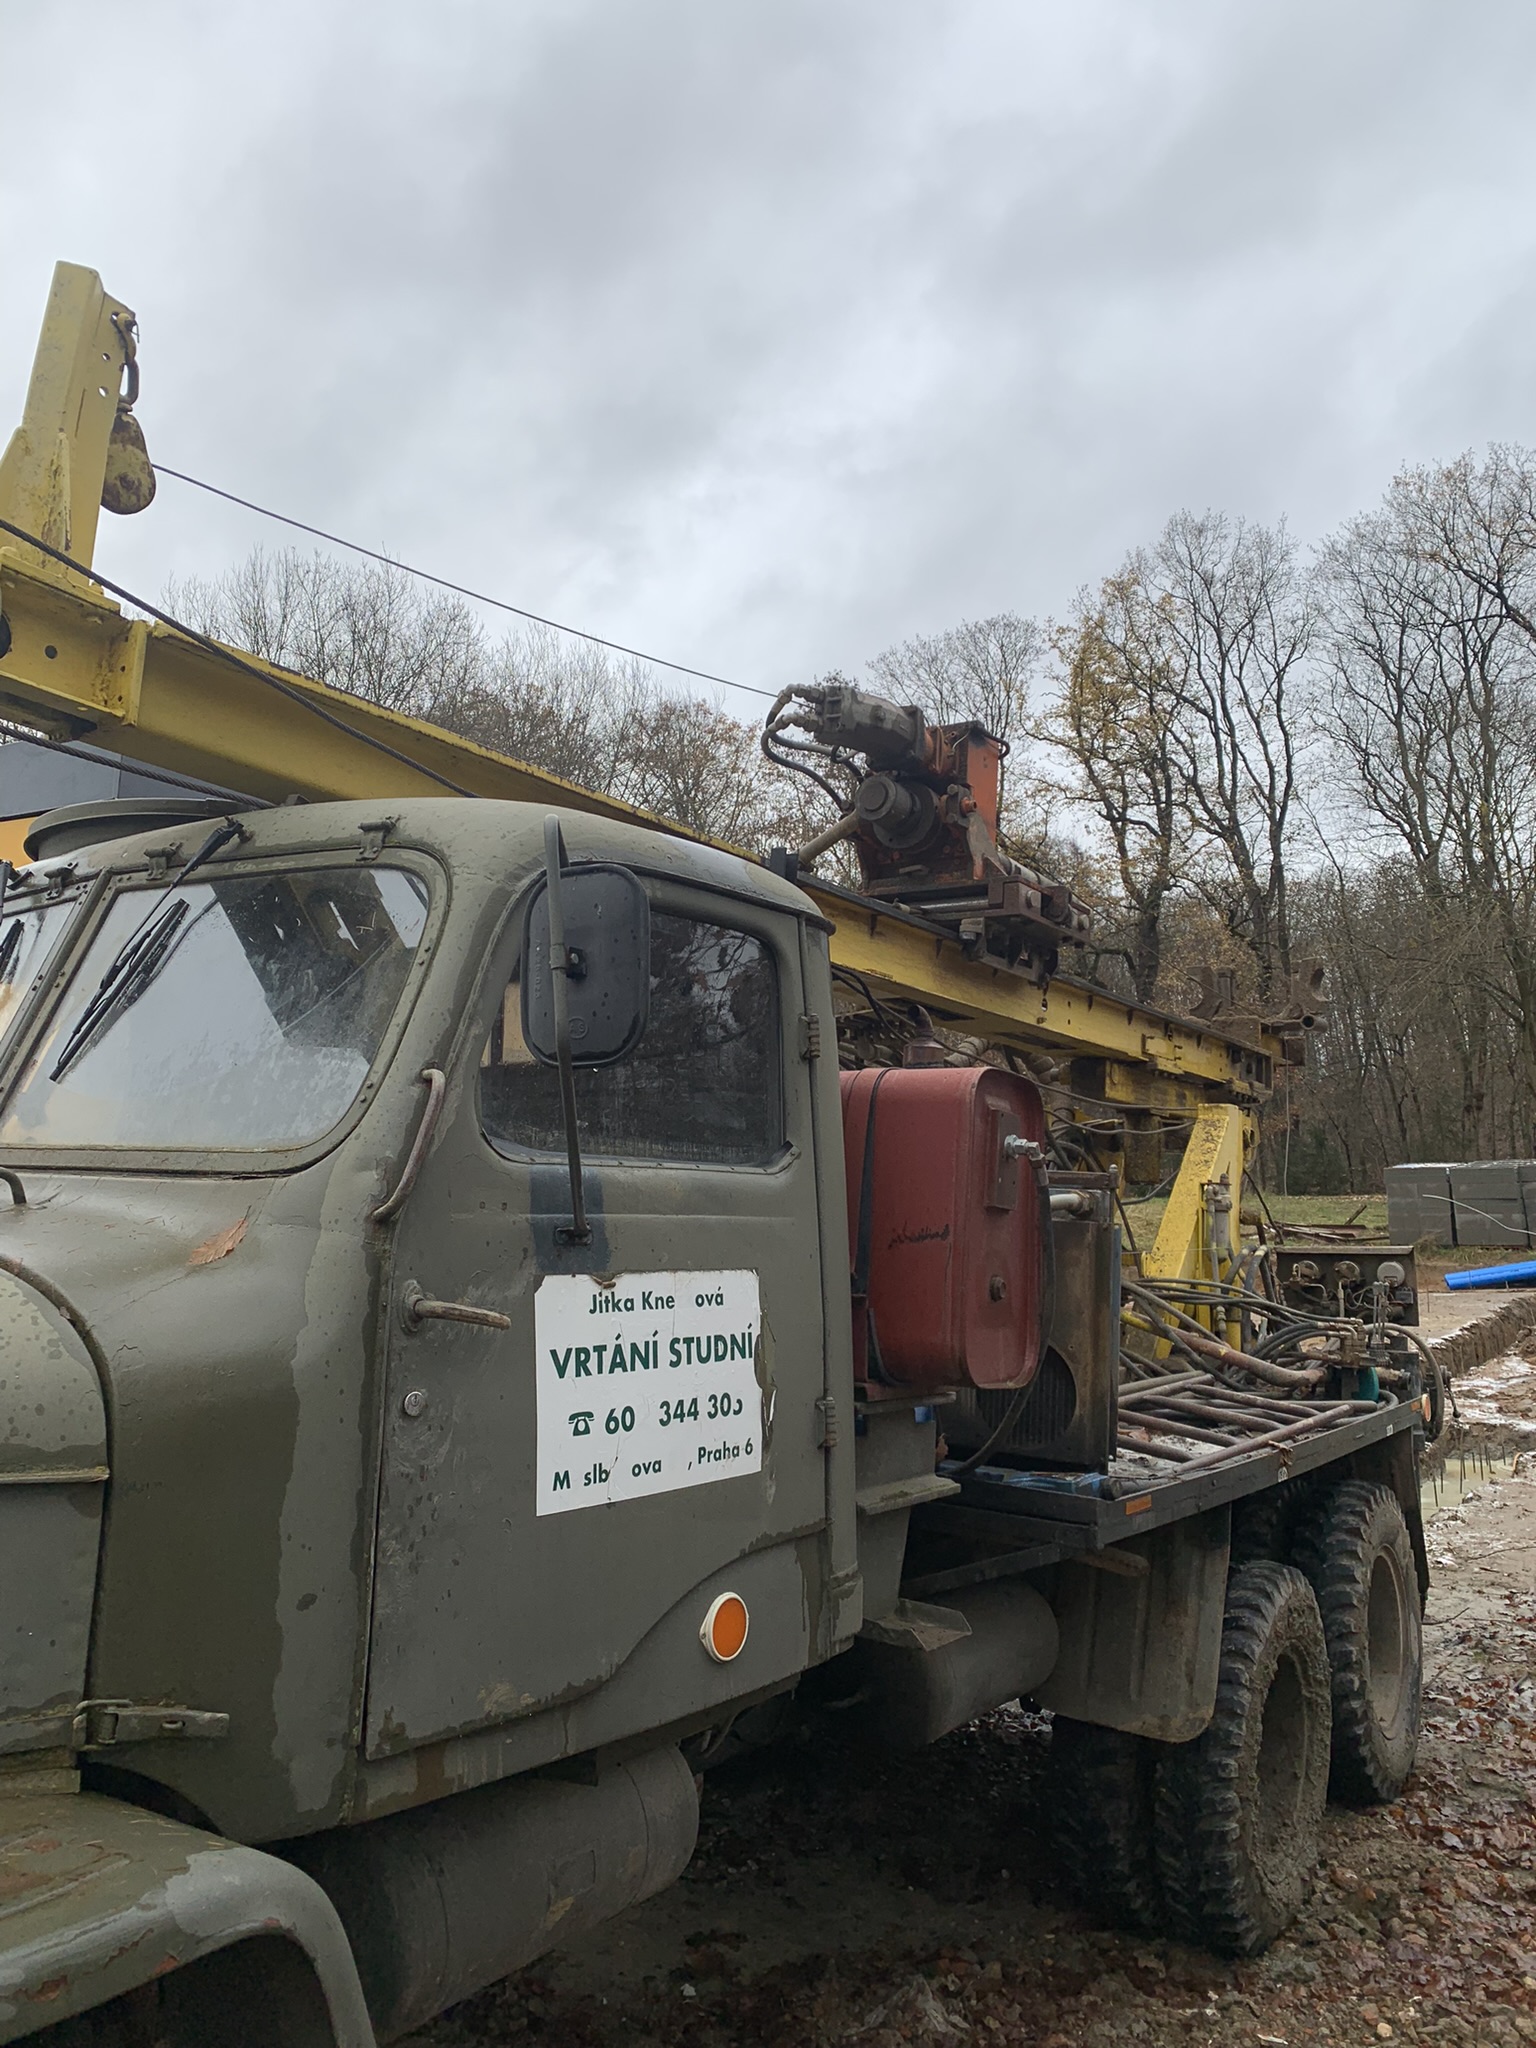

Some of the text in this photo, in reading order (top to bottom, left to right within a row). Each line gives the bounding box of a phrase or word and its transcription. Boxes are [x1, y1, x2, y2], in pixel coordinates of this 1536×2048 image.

[588, 1290, 635, 1315] Jitka
[549, 1322, 754, 1380] VRTÁNÍ STUDNÍ
[658, 1397, 700, 1427] 344
[697, 1440, 740, 1465] Praha
[744, 1437, 754, 1456] 6
